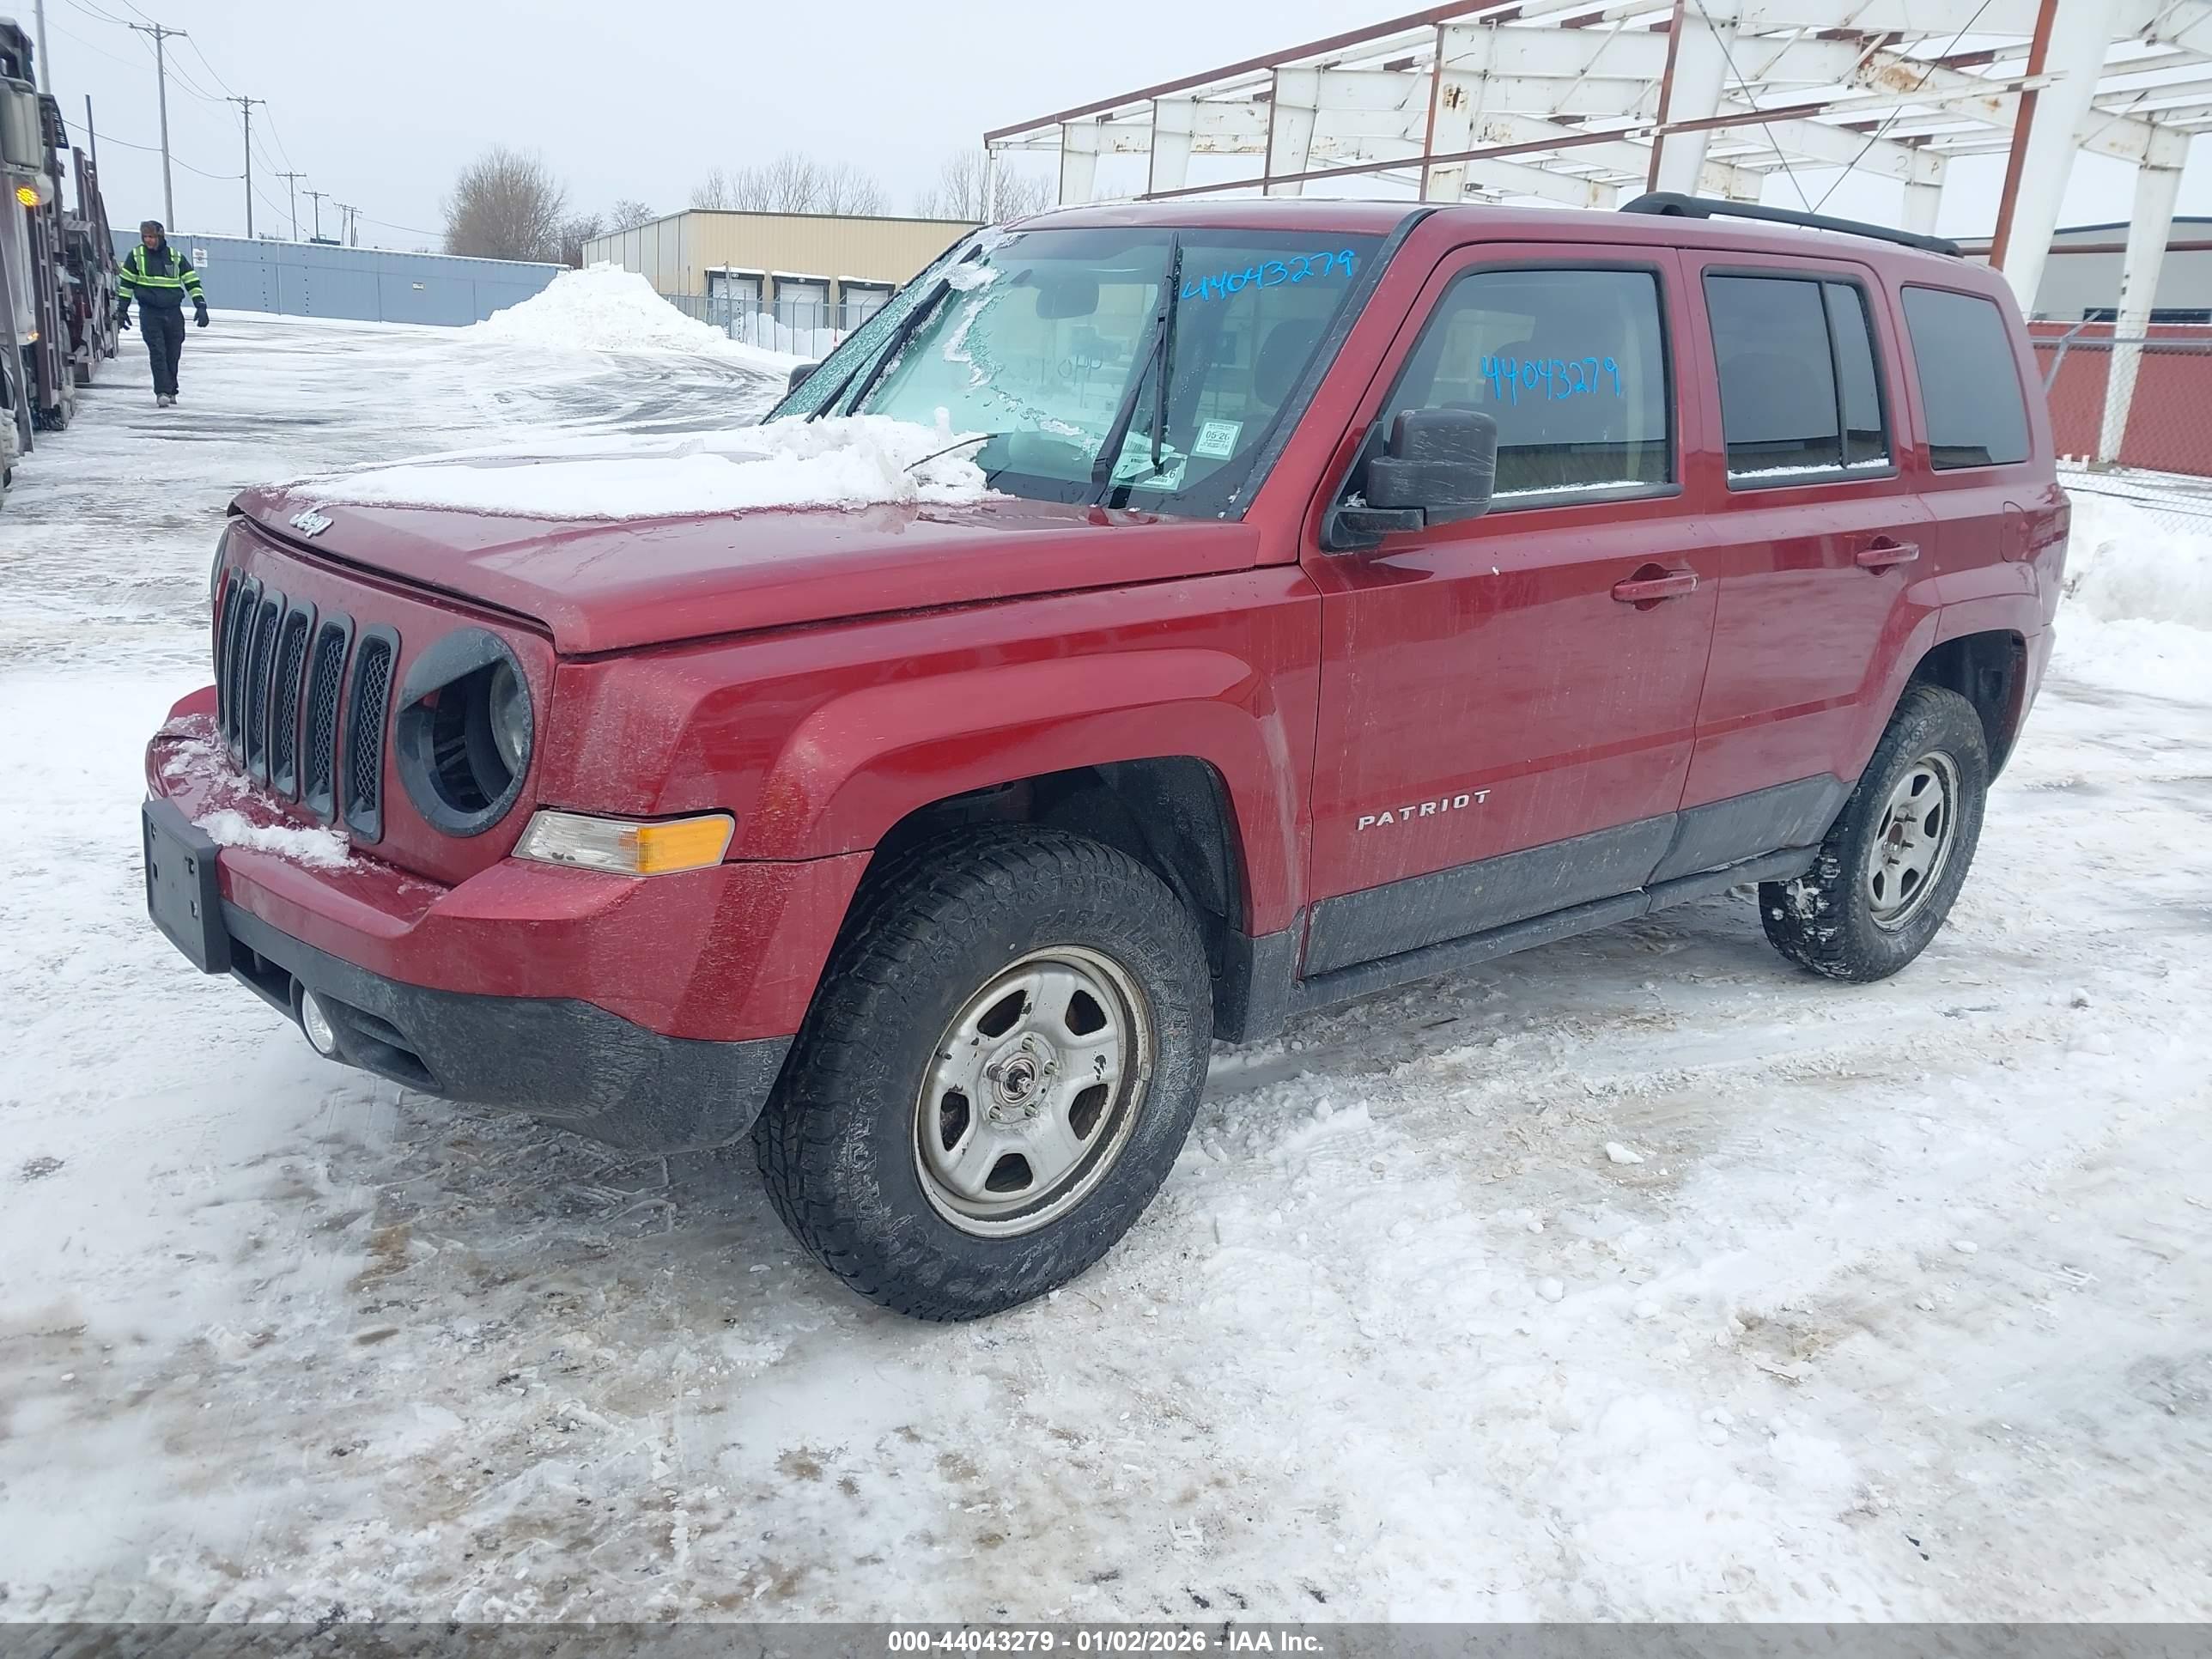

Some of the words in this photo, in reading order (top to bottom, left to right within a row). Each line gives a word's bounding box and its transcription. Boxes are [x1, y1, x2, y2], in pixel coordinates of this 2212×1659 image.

[1181, 248, 1356, 301] 44043279
[1480, 356, 1621, 406] 44043279
[289, 506, 334, 538] Jeep
[1356, 789, 1492, 831] PATRIOT
